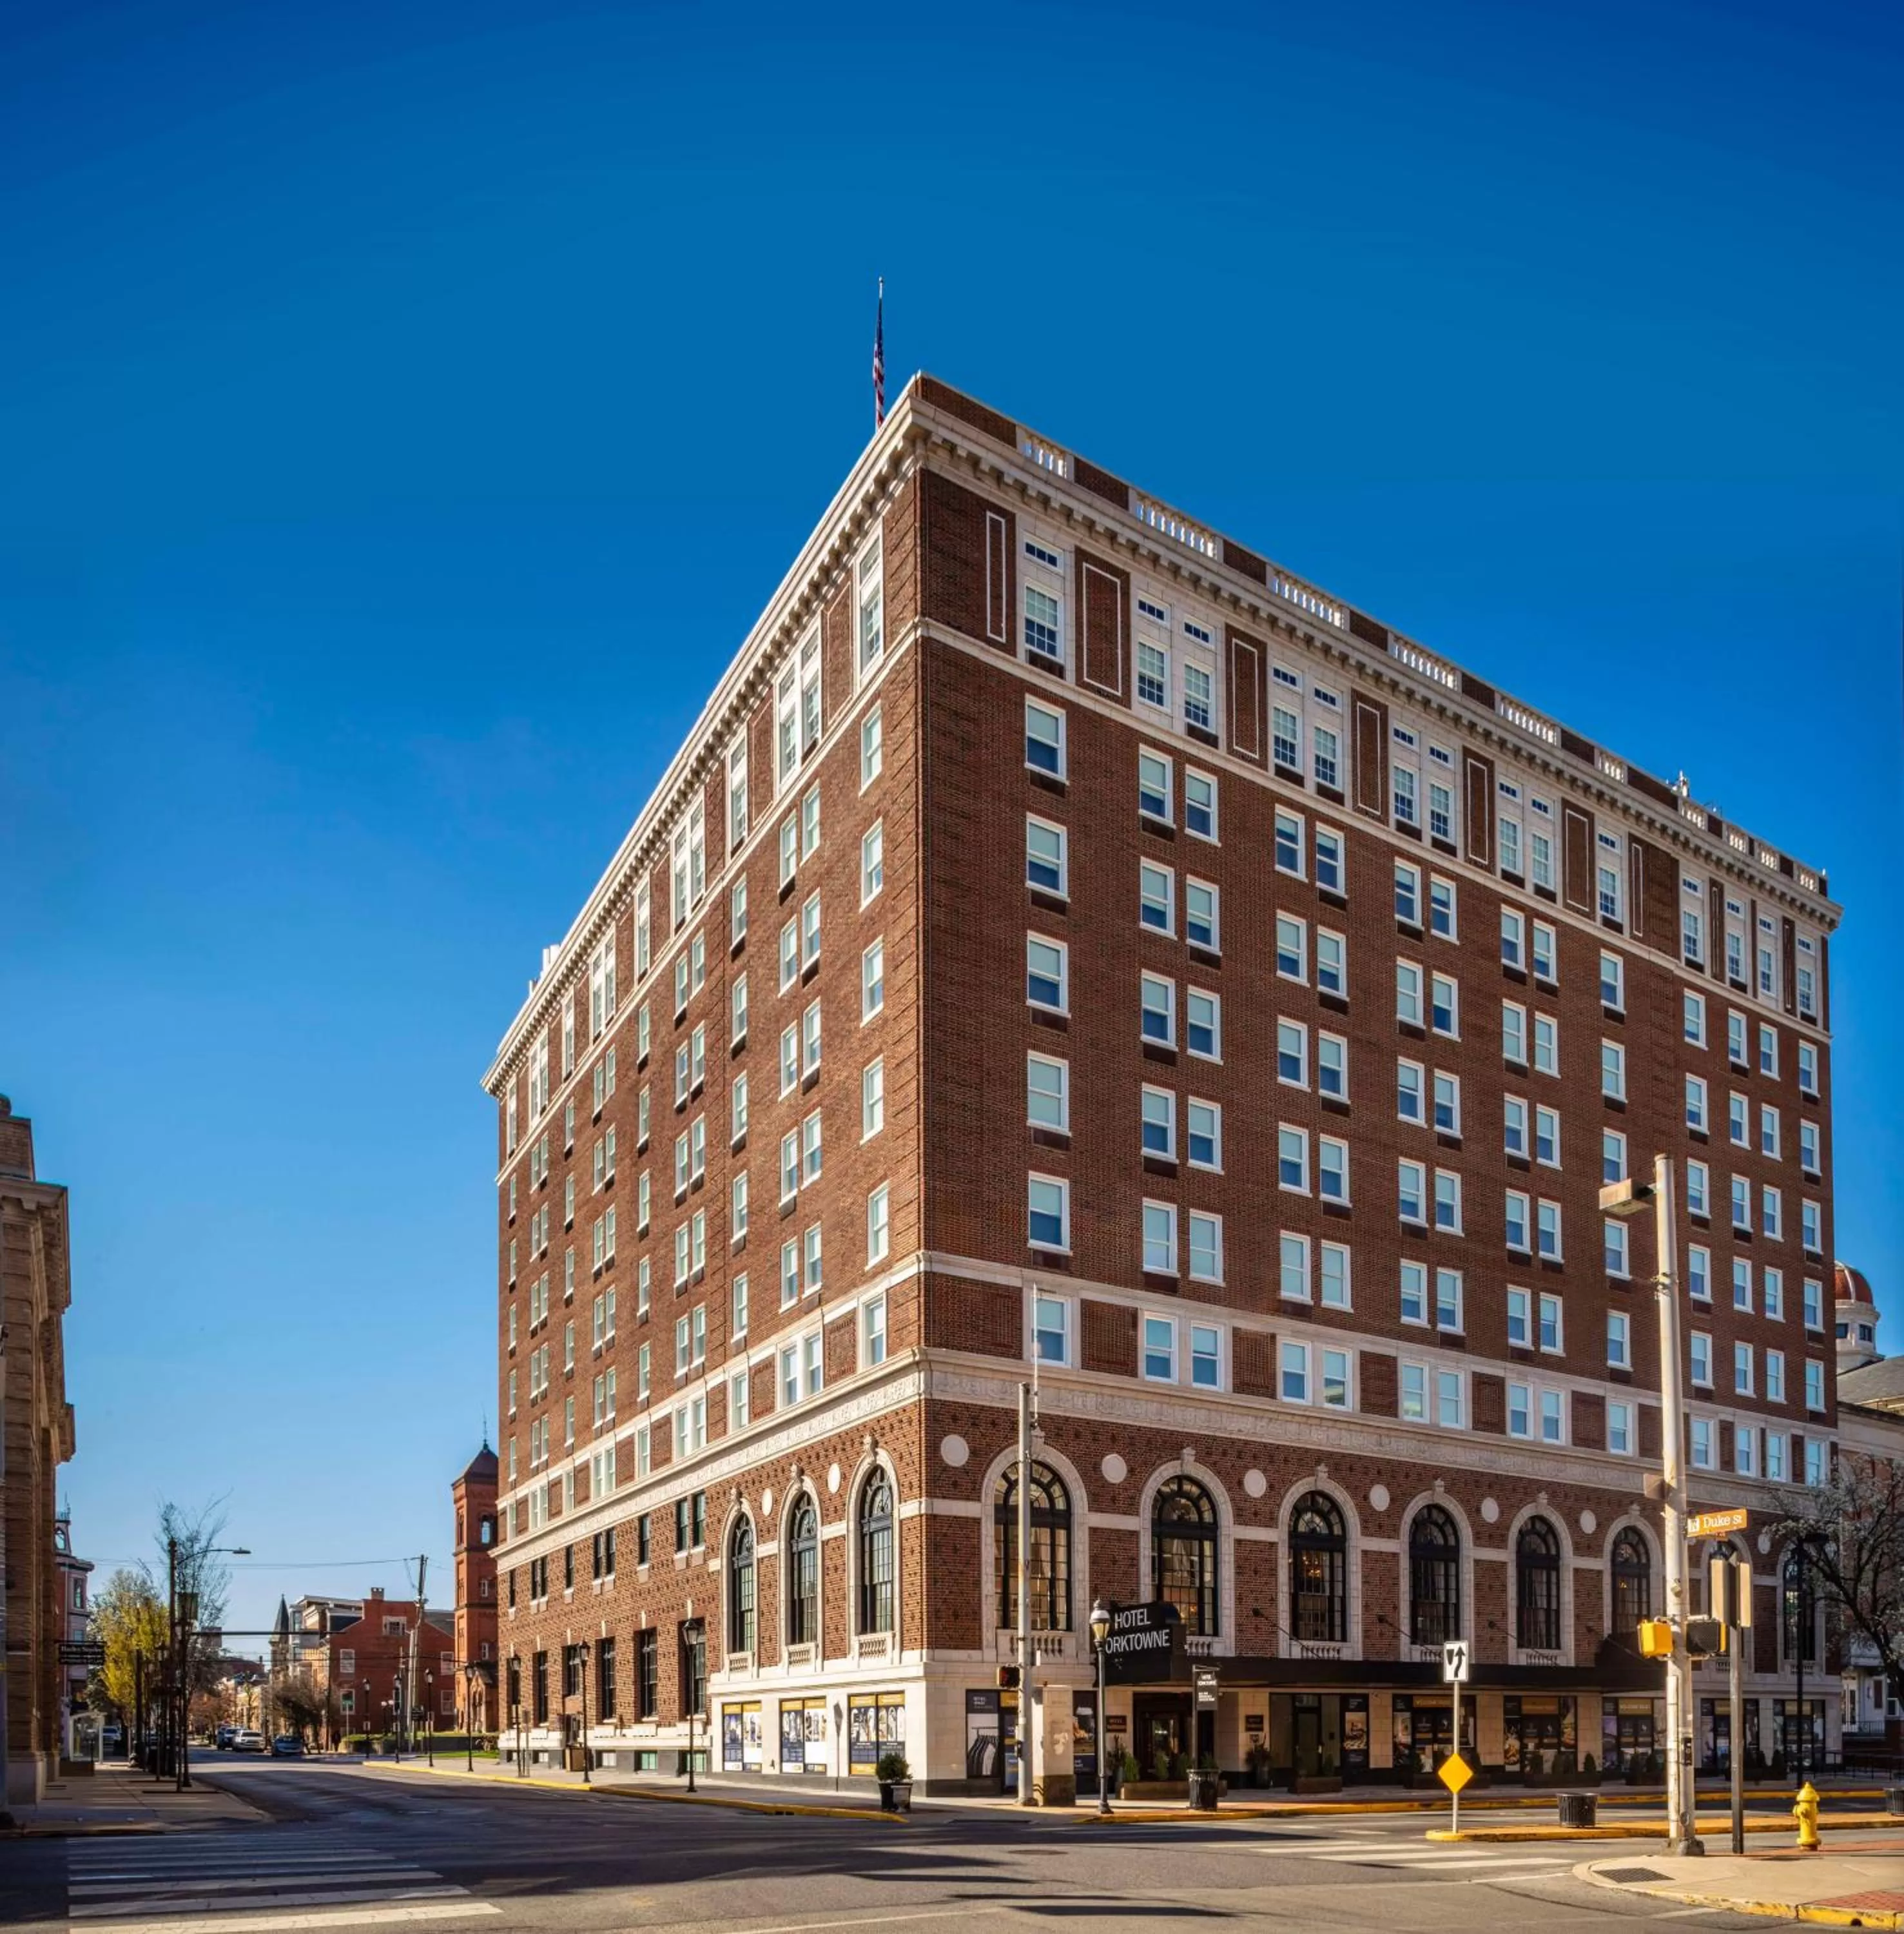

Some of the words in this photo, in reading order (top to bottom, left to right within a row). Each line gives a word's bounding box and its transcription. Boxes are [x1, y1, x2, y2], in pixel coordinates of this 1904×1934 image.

[1704, 1515, 1730, 1528] Duke
[1114, 1608, 1151, 1630] HOTEL
[1105, 1629, 1171, 1654] ORKTOWNE
